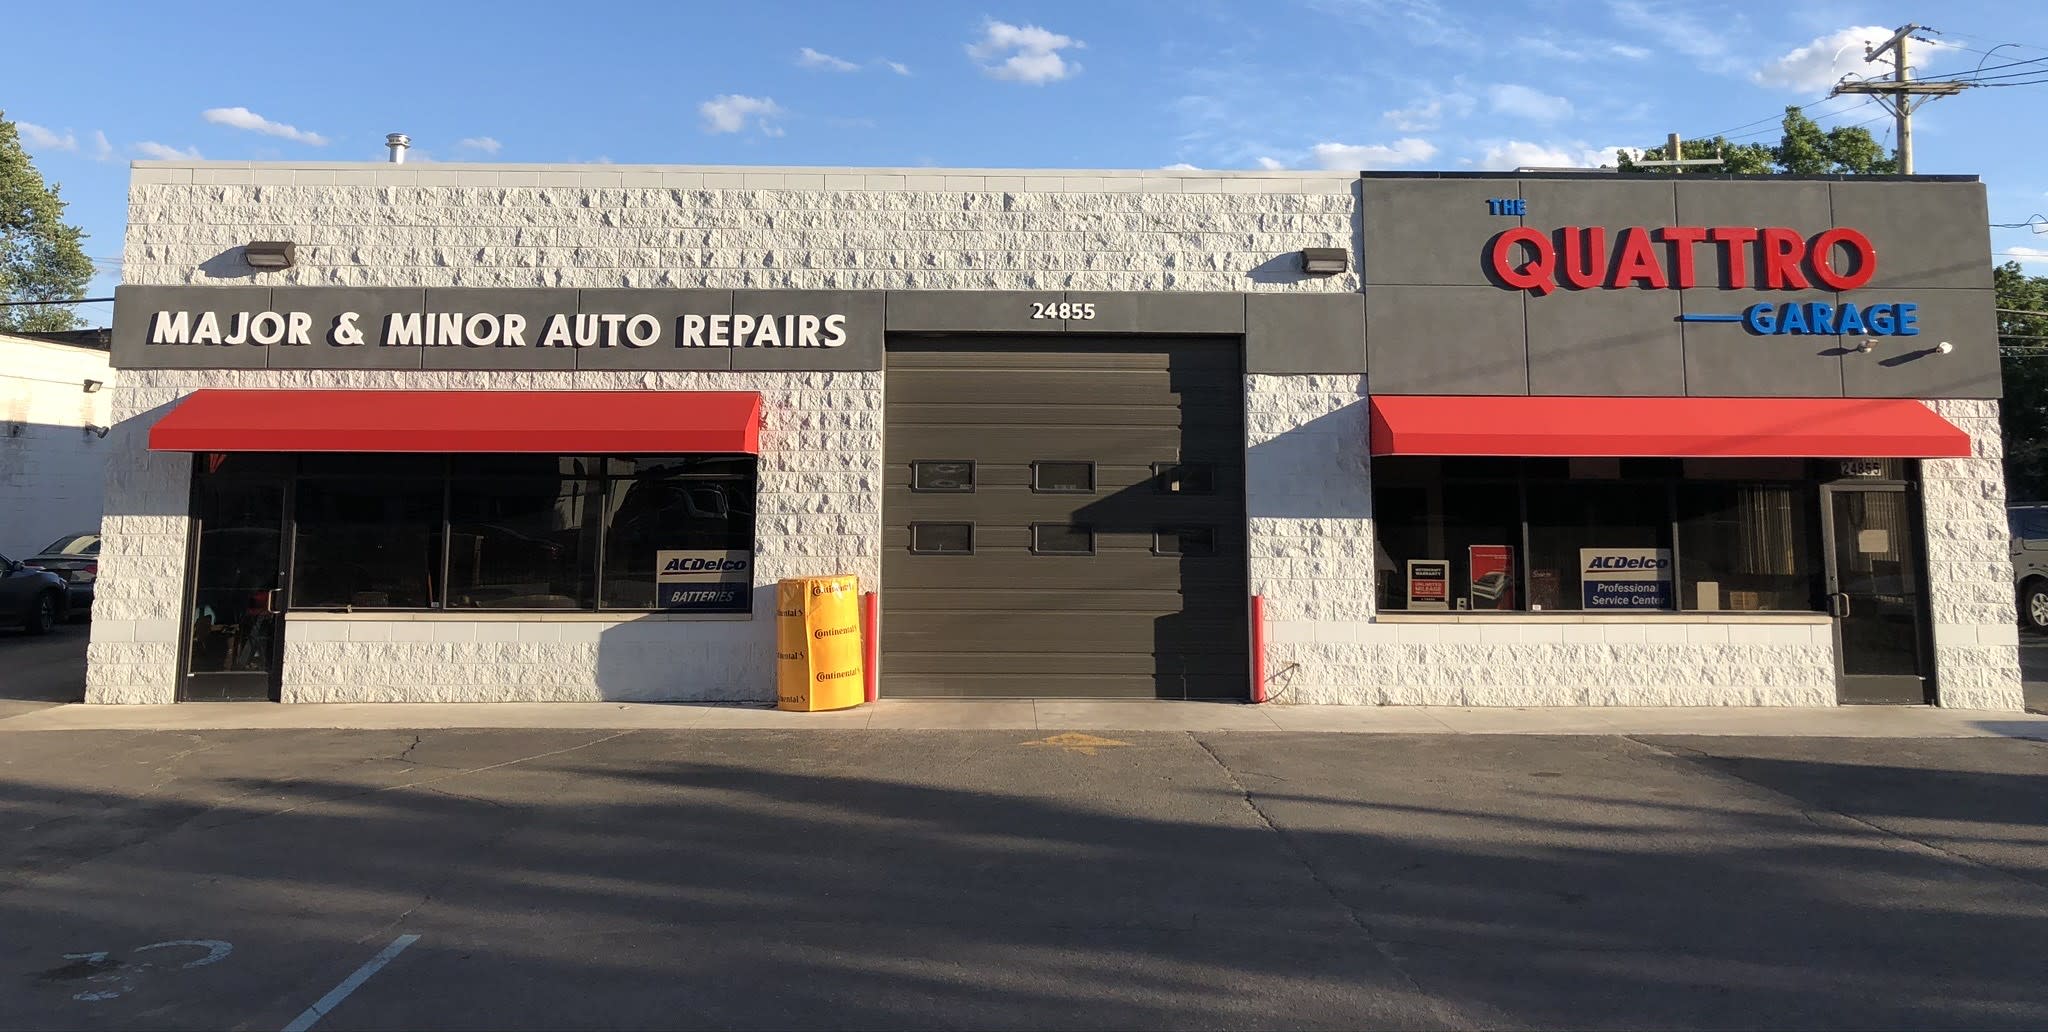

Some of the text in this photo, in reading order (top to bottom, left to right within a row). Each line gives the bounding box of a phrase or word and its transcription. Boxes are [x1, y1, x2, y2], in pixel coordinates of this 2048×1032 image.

[1490, 198, 1527, 216] THE
[1492, 226, 1878, 296] QUATTRO
[1033, 302, 1096, 320] 24855
[1747, 302, 1921, 336] GARAGE
[151, 310, 848, 348] MAJOR & MINOR AUTO REPAIRS
[1840, 462, 1881, 476] 24855
[664, 558, 747, 571] ACDelco
[1588, 556, 1669, 569] ACDelco
[1597, 583, 1660, 593] Professional
[671, 591, 735, 603] BATTERIES
[1592, 595, 1665, 605] Service Center
[816, 668, 858, 682] Continental
